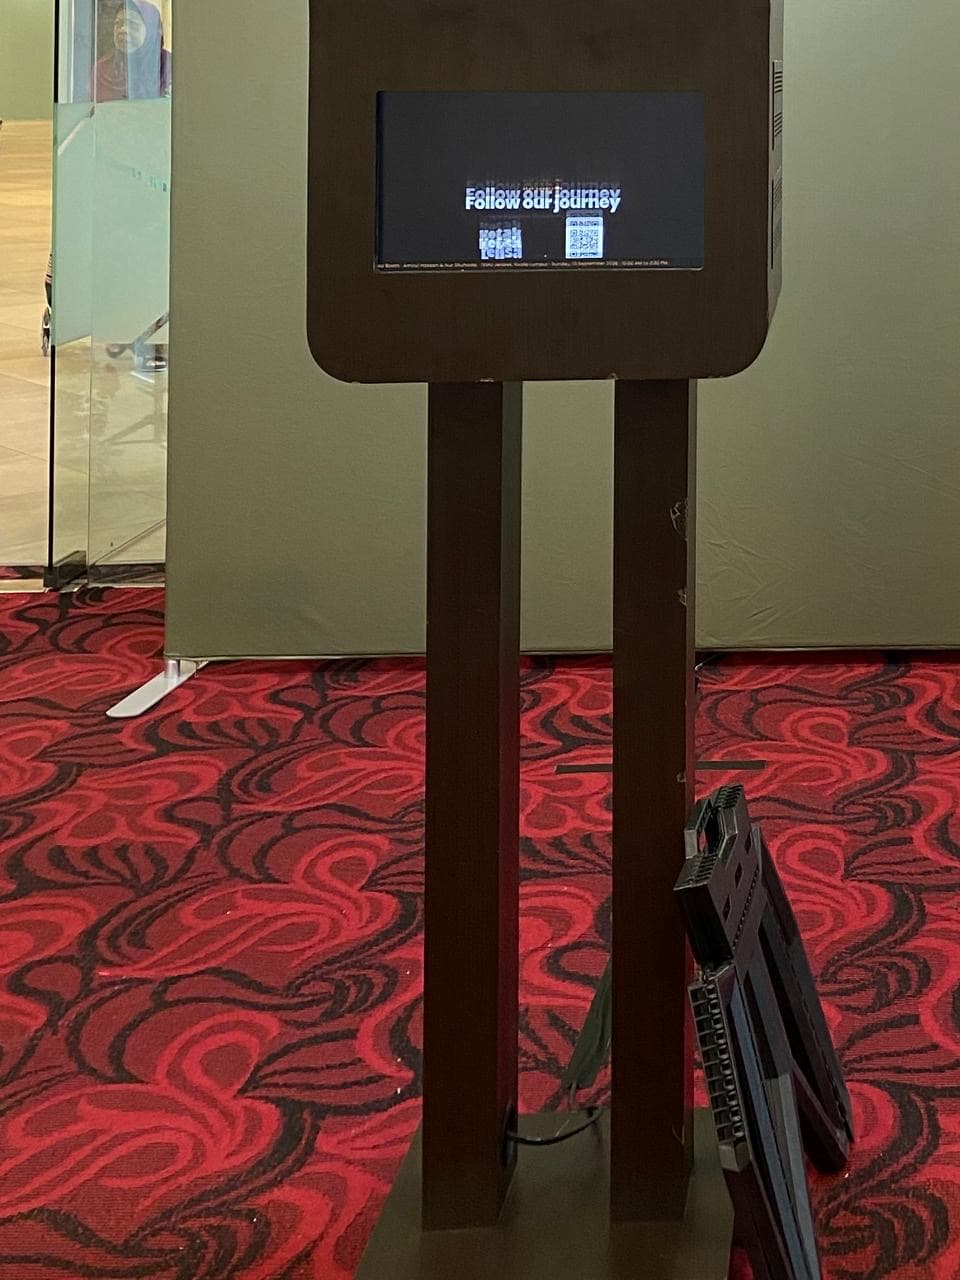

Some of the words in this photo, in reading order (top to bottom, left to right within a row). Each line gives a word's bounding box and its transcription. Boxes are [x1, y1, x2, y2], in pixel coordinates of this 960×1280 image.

[465, 189, 521, 210] Follow
[522, 189, 553, 210] our
[553, 187, 621, 213] journey
